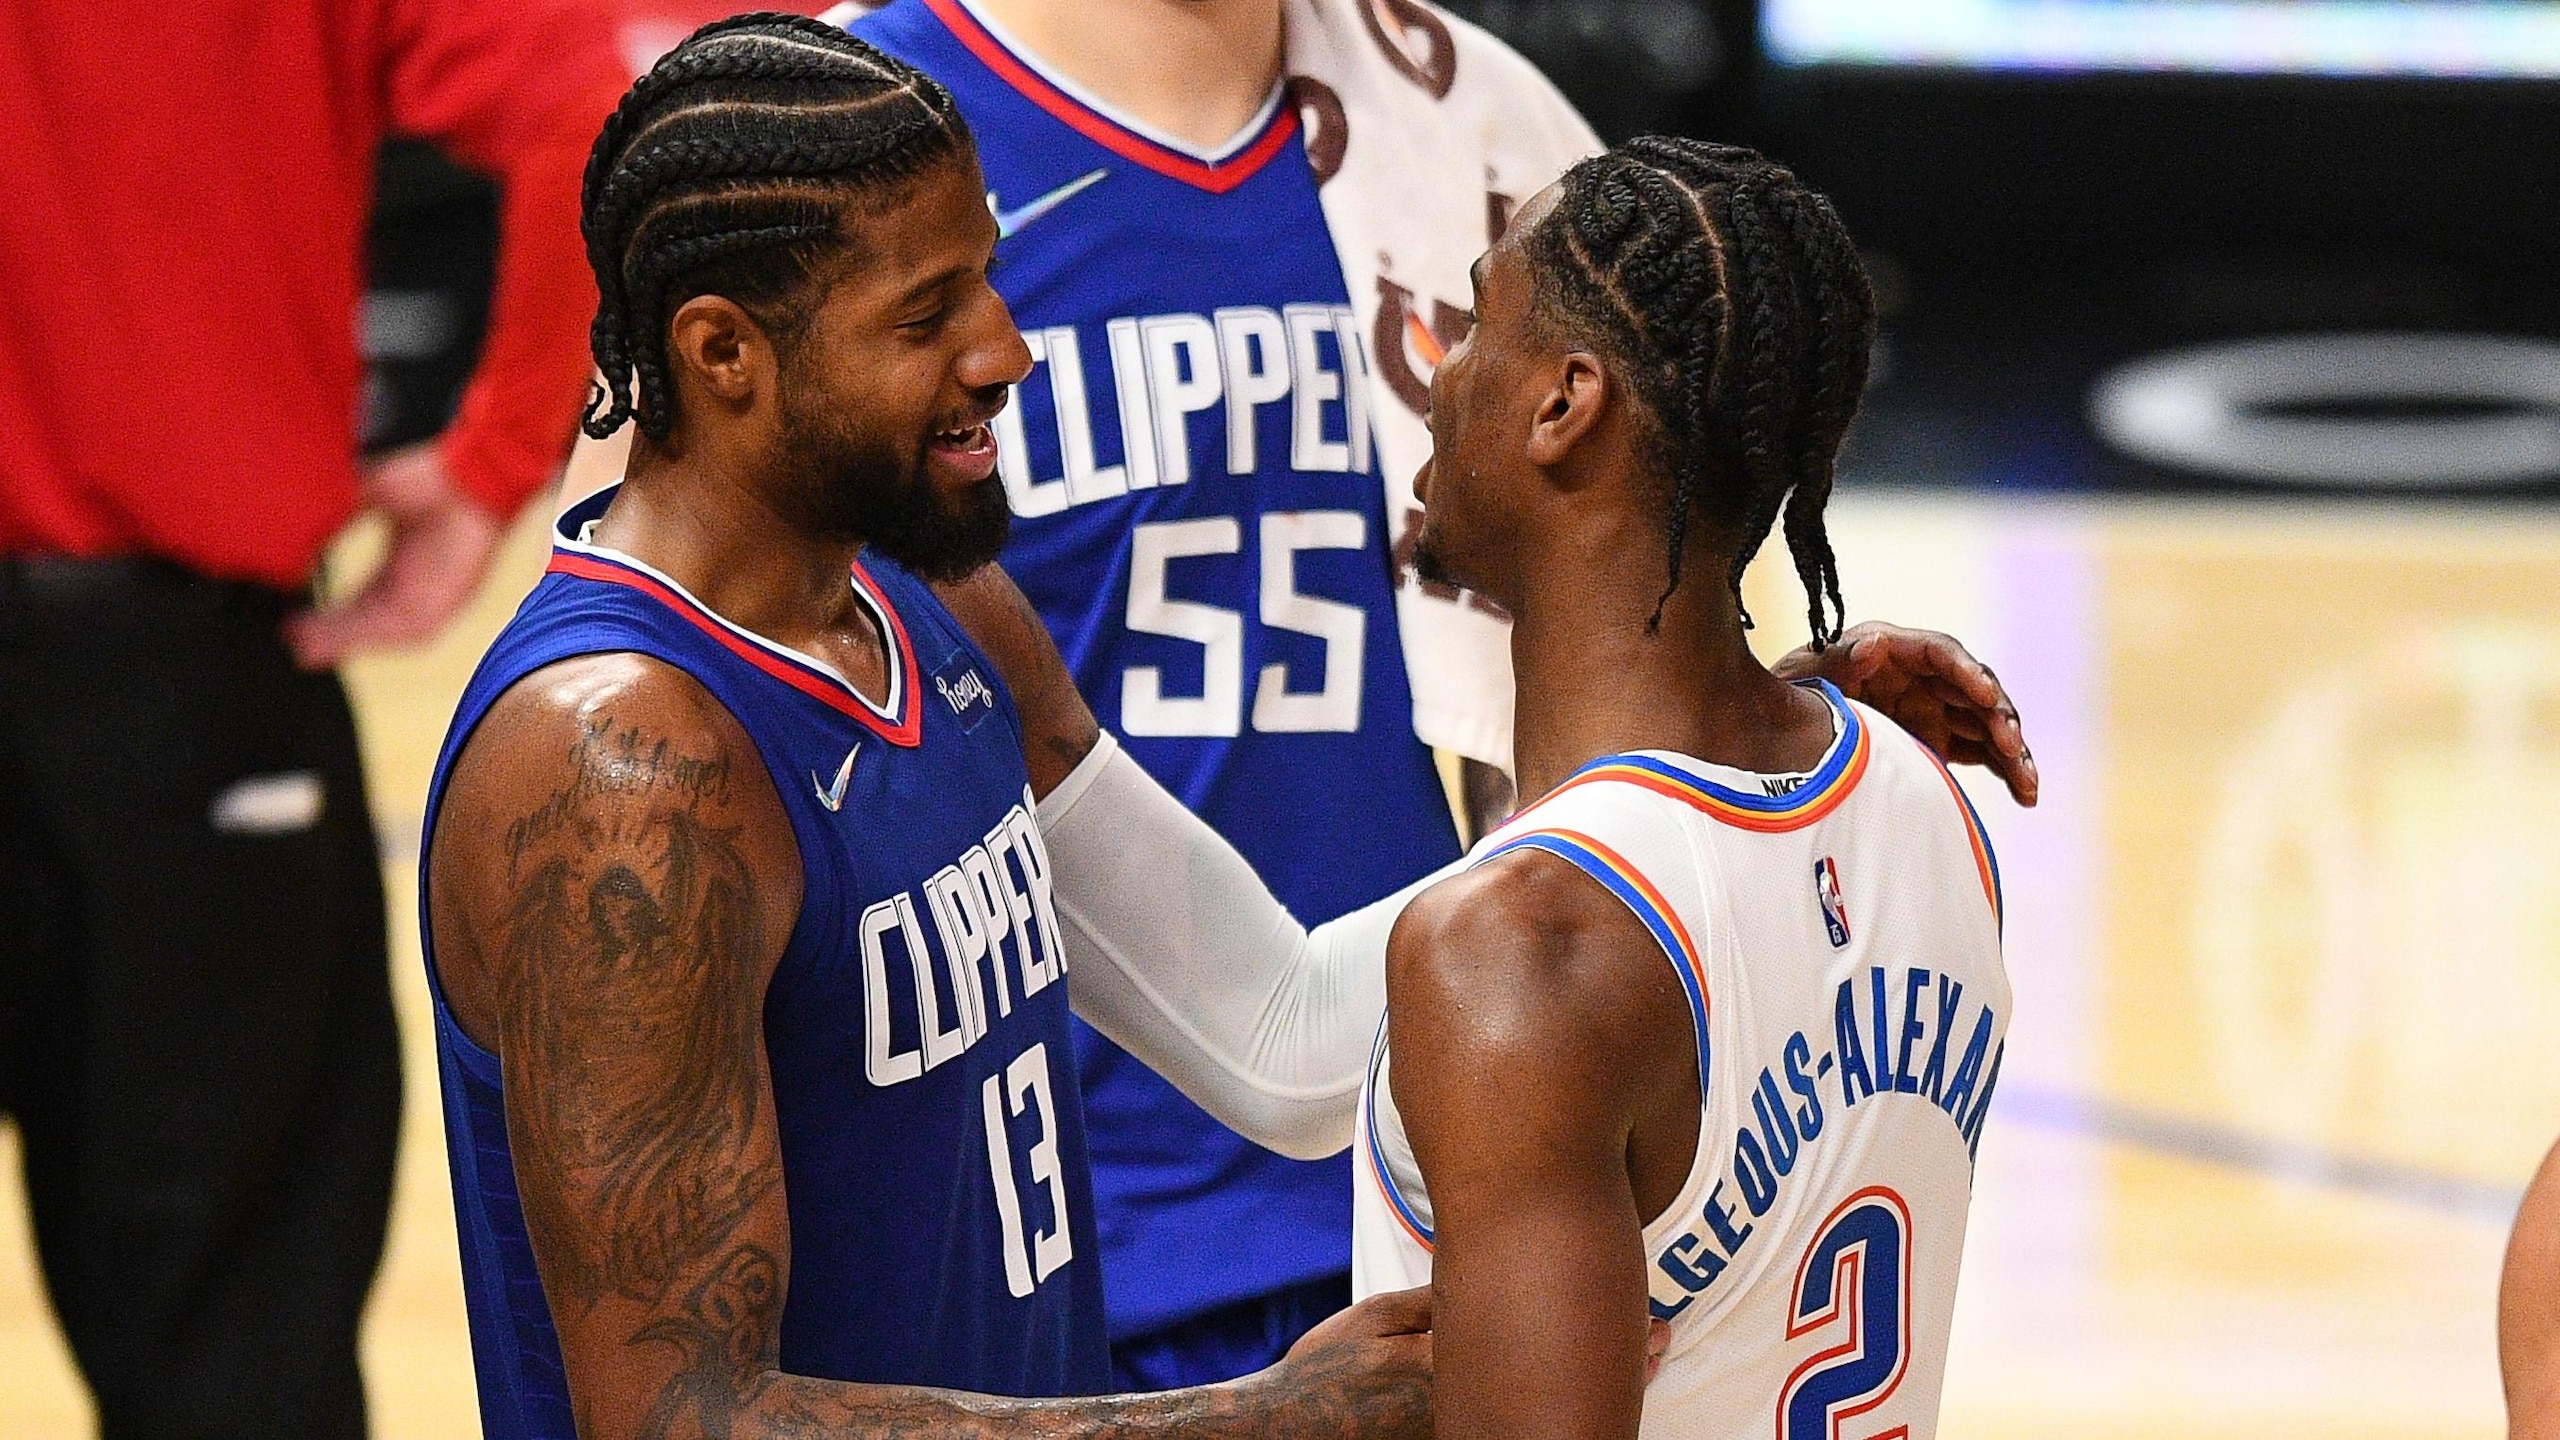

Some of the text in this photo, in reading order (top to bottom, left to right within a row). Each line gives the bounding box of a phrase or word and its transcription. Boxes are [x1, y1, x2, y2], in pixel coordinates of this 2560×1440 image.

[935, 668, 993, 715] honey
[1121, 509, 1366, 738] 55
[859, 782, 1069, 1088] CLIPPER
[983, 1041, 1073, 1298] 13
[1775, 1184, 1913, 1440] 2
